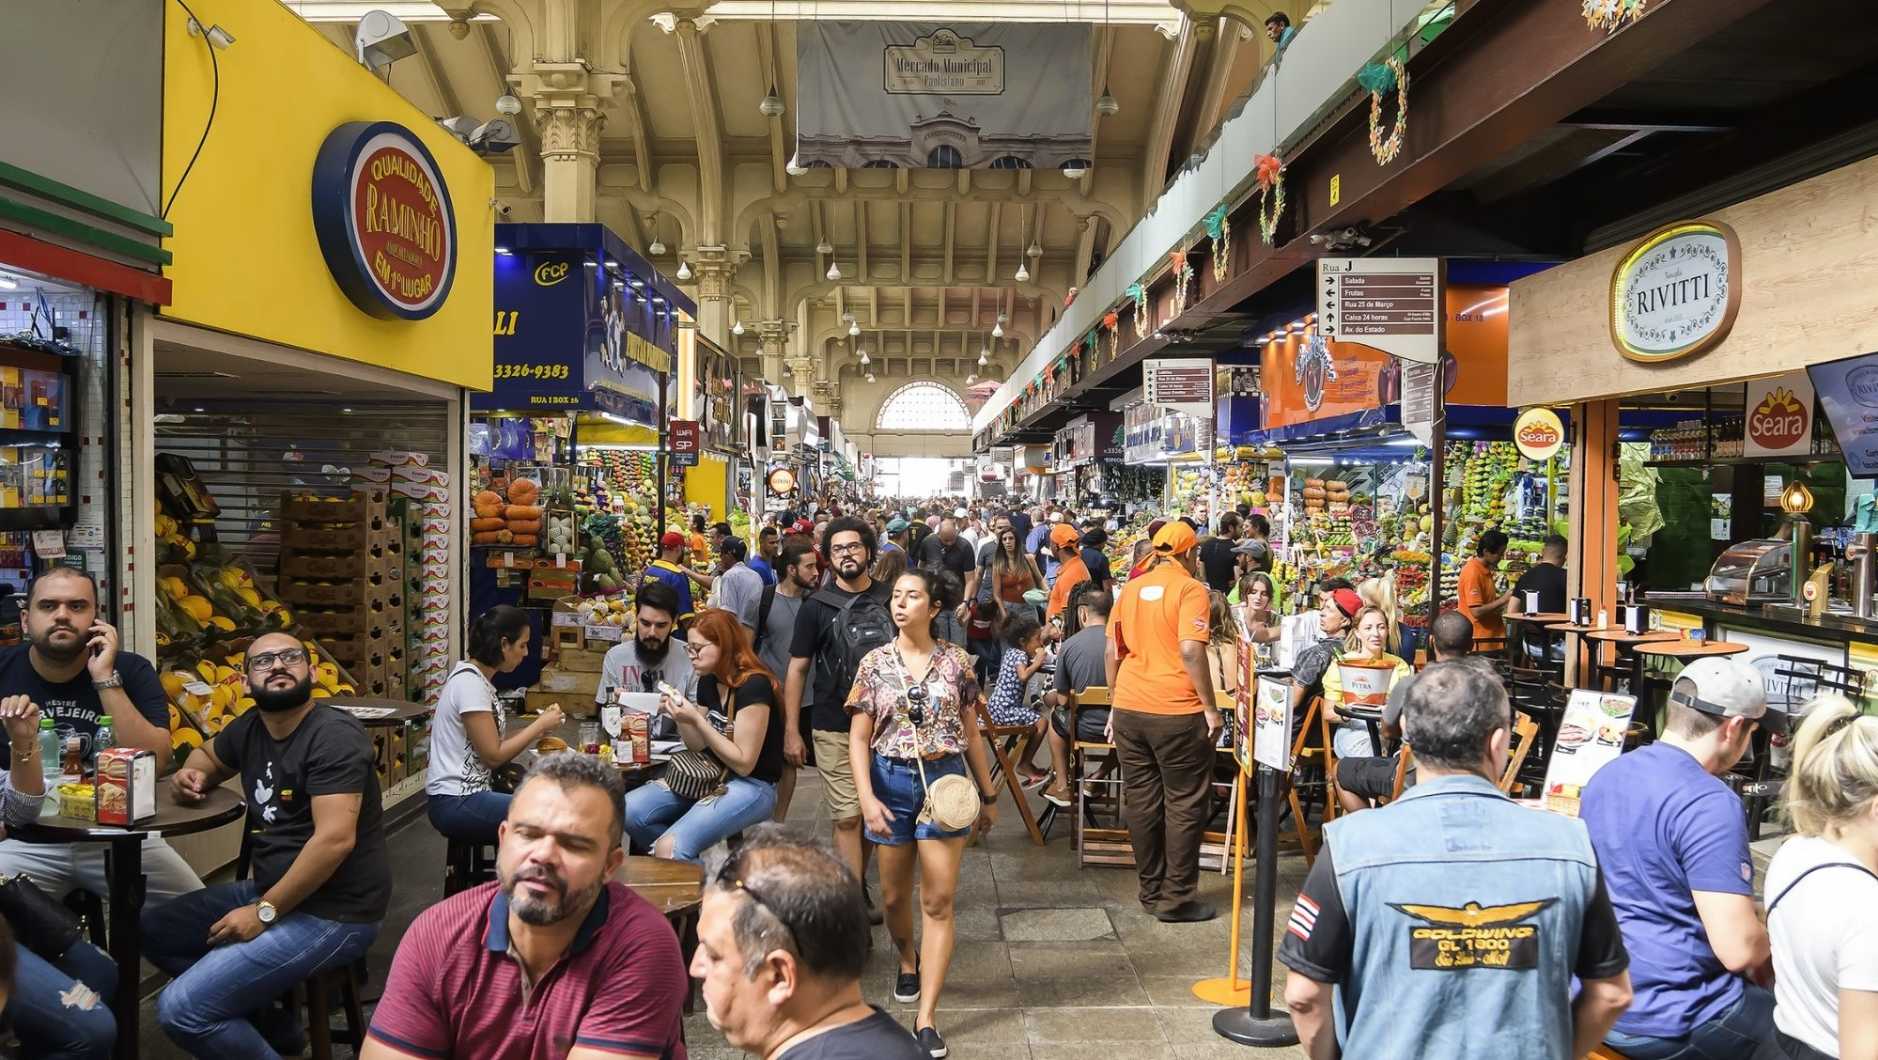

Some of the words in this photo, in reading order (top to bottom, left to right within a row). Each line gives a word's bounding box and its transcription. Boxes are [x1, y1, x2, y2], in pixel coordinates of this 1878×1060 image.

[896, 58, 940, 73] Mercado
[943, 58, 992, 75] Municipal
[371, 155, 439, 218] QUALIDADE
[366, 182, 441, 262] RAMINHO
[1322, 263, 1340, 272] Rua
[1344, 260, 1353, 272] J
[375, 251, 391, 285] EM
[401, 274, 432, 299] LUGAR
[1344, 289, 1365, 297] Frutas
[1637, 273, 1710, 315] RIVITTI
[1375, 301, 1394, 309] Março
[493, 364, 569, 380] 3326-9383
[530, 396, 547, 404] RUA
[553, 396, 569, 404] BOX
[1751, 414, 1803, 437] Seara
[1519, 431, 1556, 442] Seara
[38, 706, 102, 725] RVEJEIRO
[1413, 927, 1535, 939] GOLDWING
[1438, 939, 1460, 951] GL
